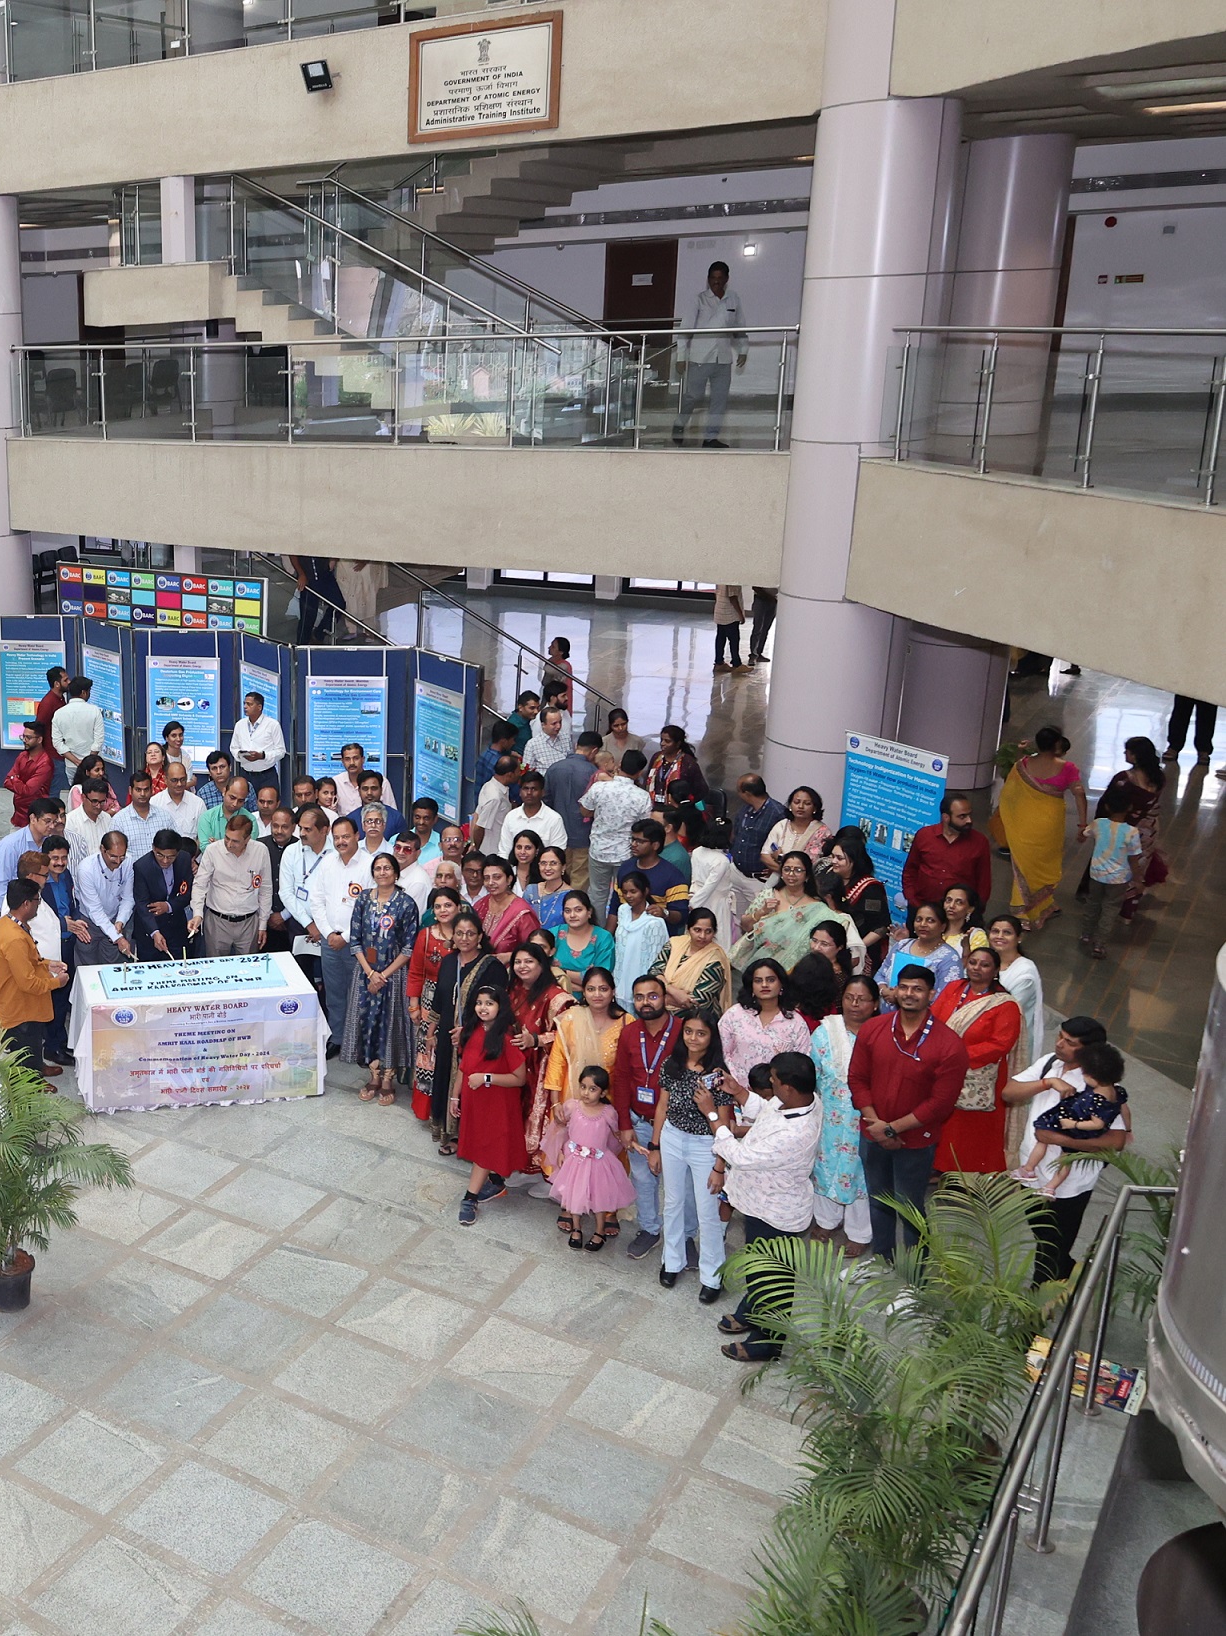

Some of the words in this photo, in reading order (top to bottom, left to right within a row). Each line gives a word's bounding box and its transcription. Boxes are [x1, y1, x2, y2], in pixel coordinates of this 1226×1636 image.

[482, 65, 507, 73] सरकार
[444, 75, 489, 86] GOVERNMENT
[449, 87, 472, 95] परमाणु
[497, 81, 518, 89] विभाग
[427, 96, 470, 107] DEPARTMENT
[484, 92, 510, 100] ATOMIC
[513, 88, 541, 96] ENERGY
[426, 114, 475, 126] Administrative
[478, 111, 507, 119] Training
[510, 107, 541, 116] Institute
[434, 105, 470, 116] प्रशासनिक
[193, 617, 206, 625] BARC
[874, 742, 888, 751] Heavy
[889, 746, 904, 754] Water
[904, 750, 918, 758] Board
[865, 747, 891, 758] Department
[910, 759, 925, 768] Energy
[223, 1002, 249, 1010] BOARD
